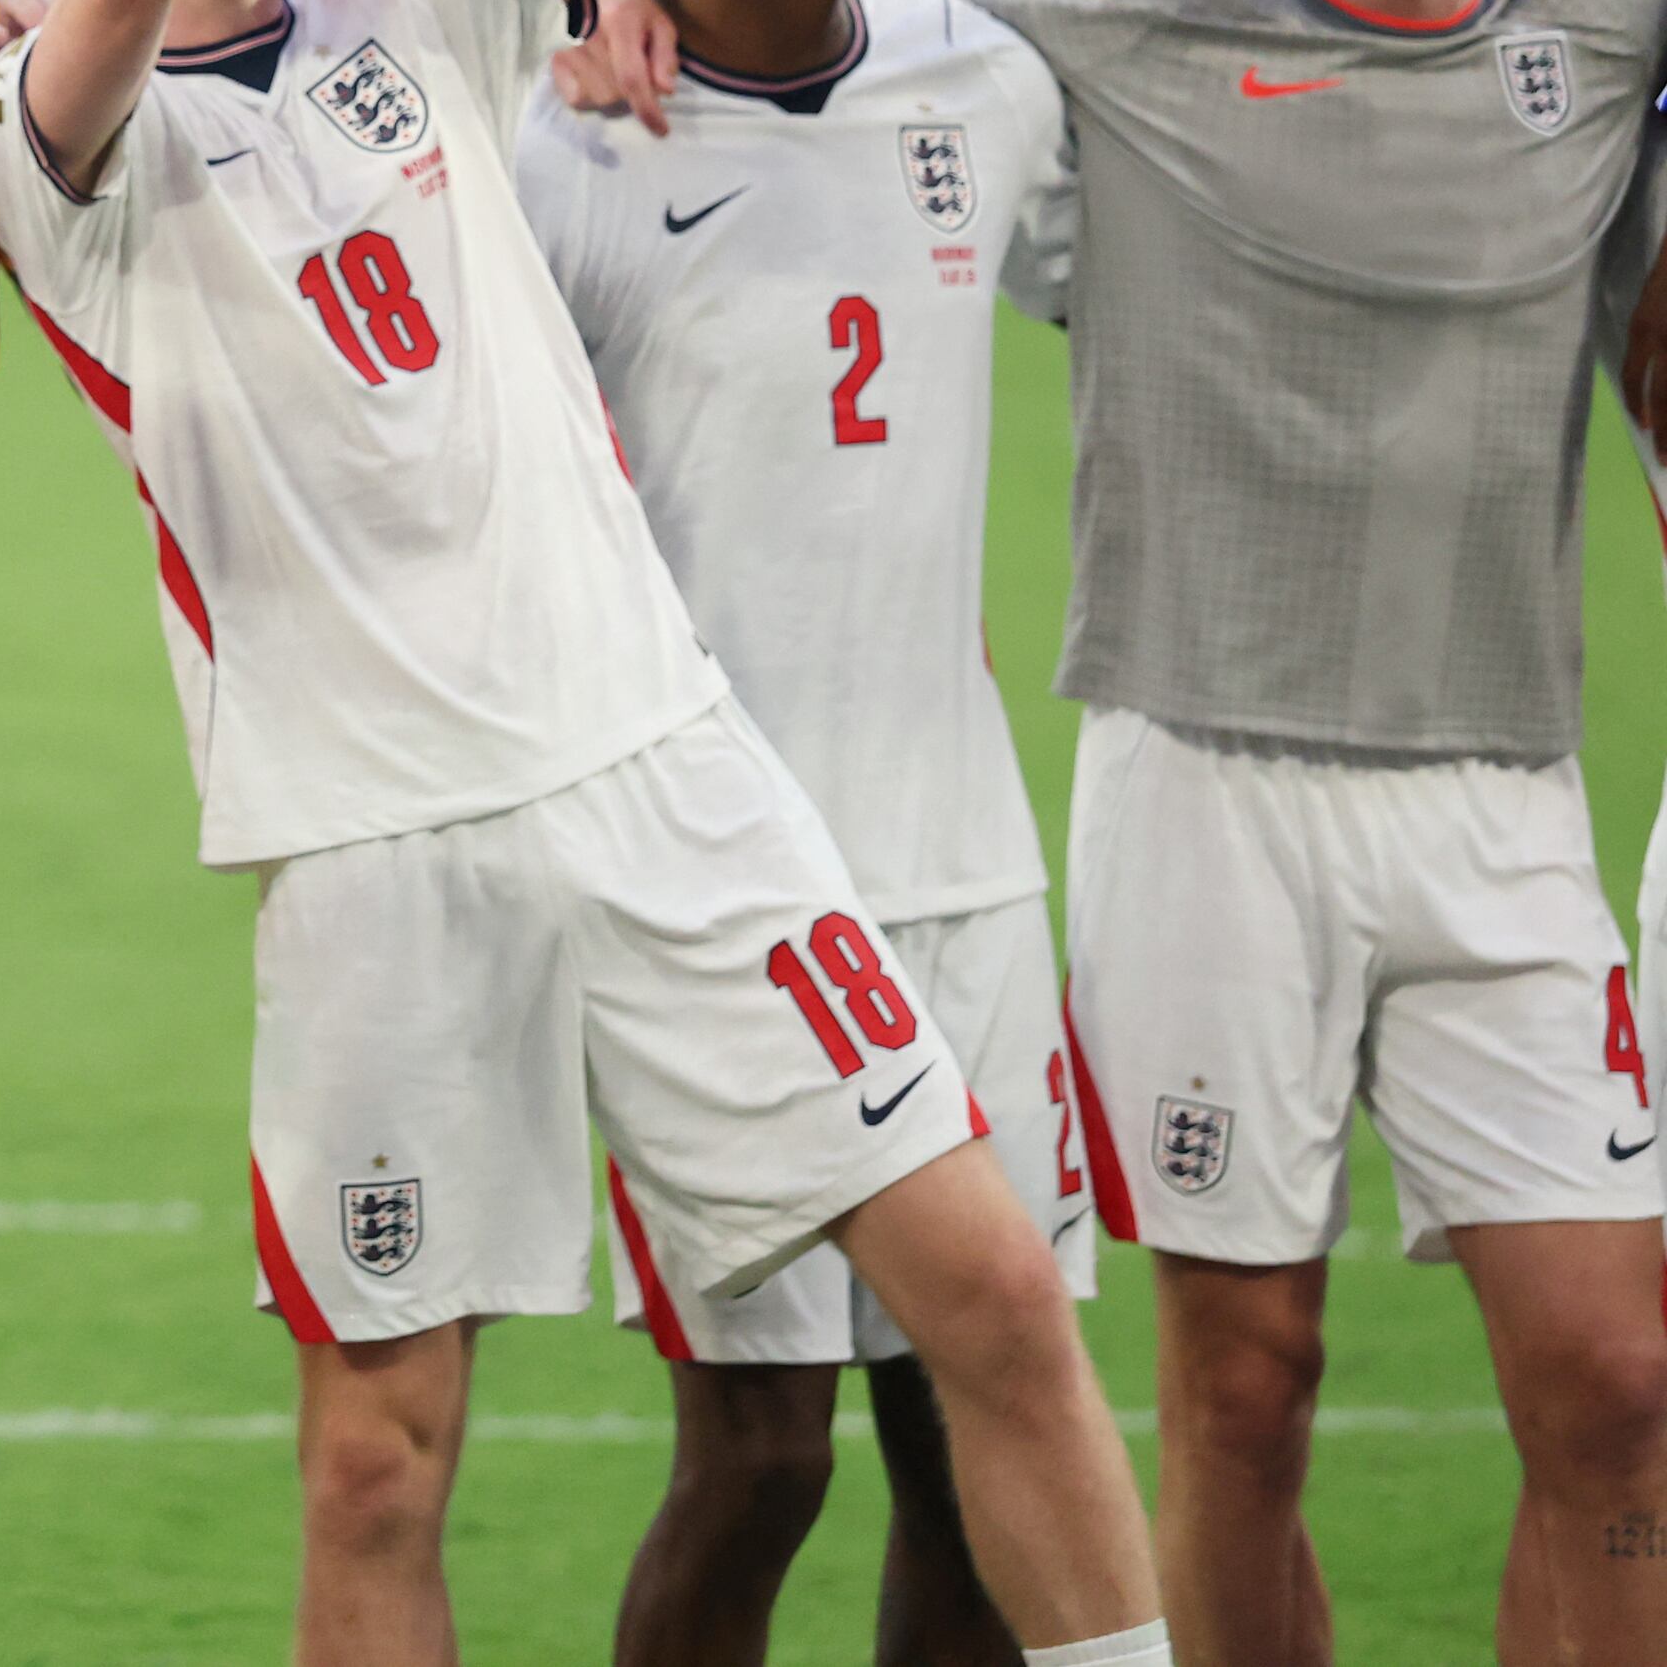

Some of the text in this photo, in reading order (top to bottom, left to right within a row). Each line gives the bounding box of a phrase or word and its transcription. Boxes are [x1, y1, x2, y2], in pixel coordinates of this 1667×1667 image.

[296, 229, 441, 387] 18
[827, 294, 889, 446] 2
[766, 910, 918, 1080] 18
[1605, 964, 1649, 1109] 4
